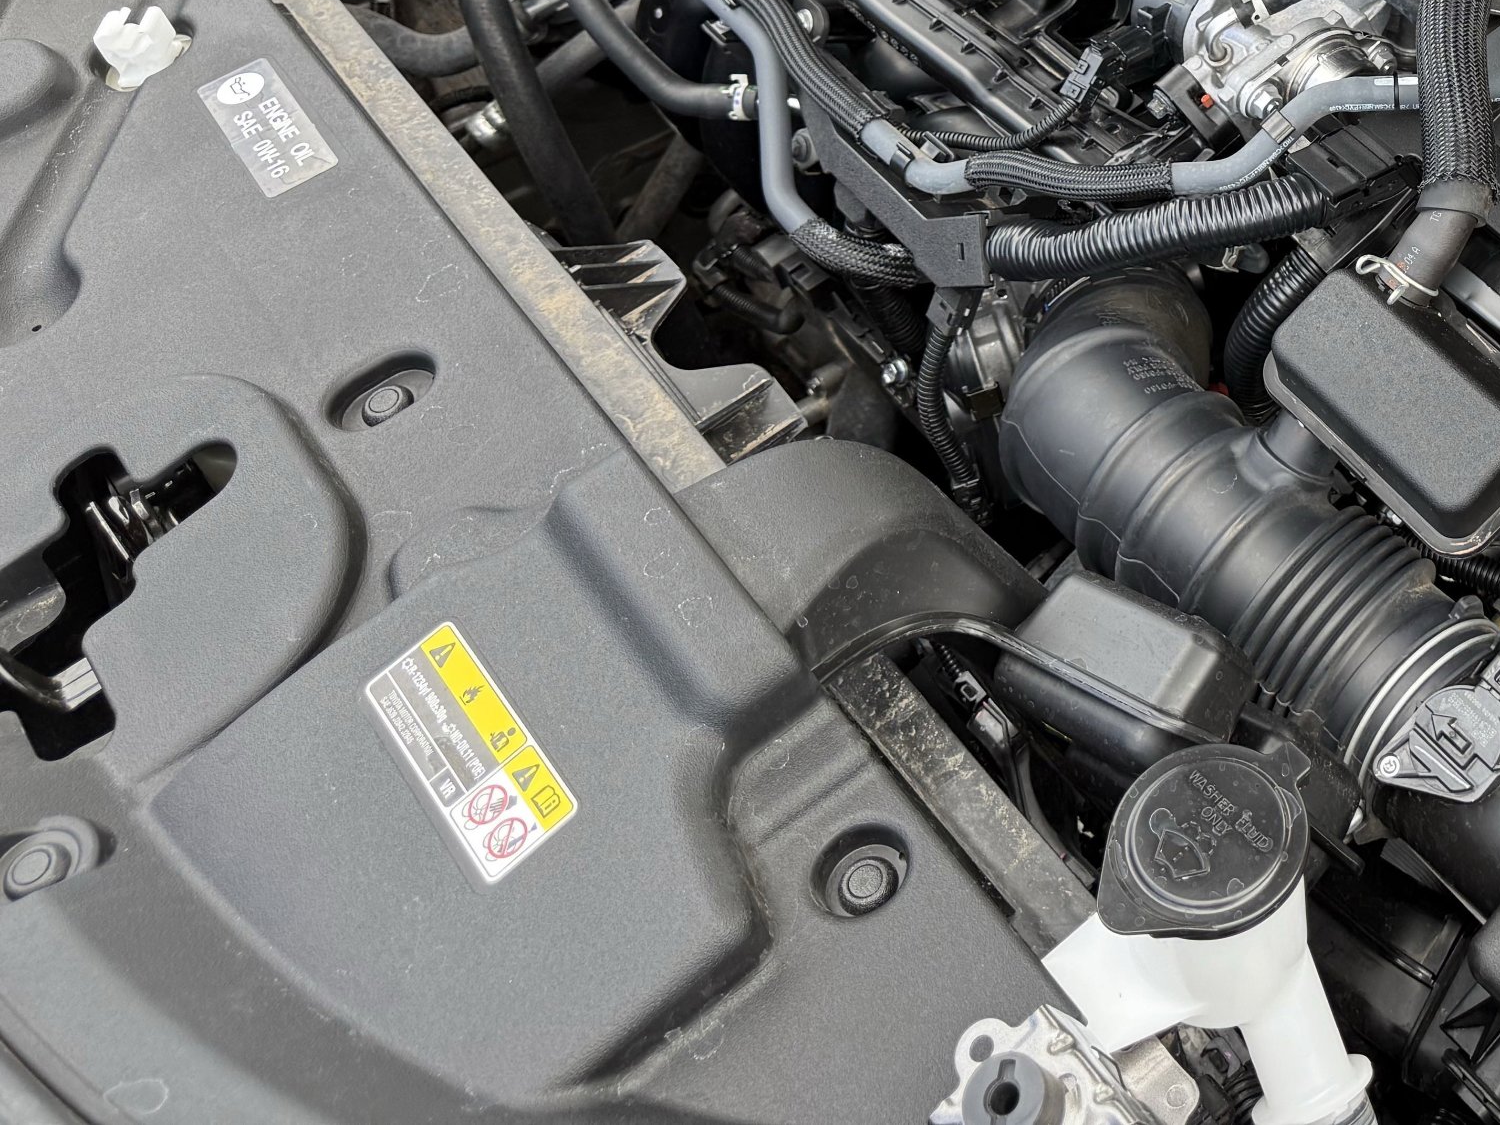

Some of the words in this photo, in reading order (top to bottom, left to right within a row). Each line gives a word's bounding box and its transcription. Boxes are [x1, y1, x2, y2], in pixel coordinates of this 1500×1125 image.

[231, 108, 264, 139] SAE
[251, 137, 291, 180] 0W-16
[257, 95, 301, 142] ENGINE
[287, 139, 317, 167] OIL
[378, 695, 391, 709] SAE
[386, 689, 404, 711] TOYOTA
[397, 705, 414, 726] MOTOR
[407, 721, 434, 757] CORPORATION
[437, 777, 457, 799] VR
[464, 755, 487, 781] (POE)
[1187, 767, 1236, 817] WASHER
[1234, 814, 1270, 851] FLUID
[1199, 803, 1233, 837] ONLY
